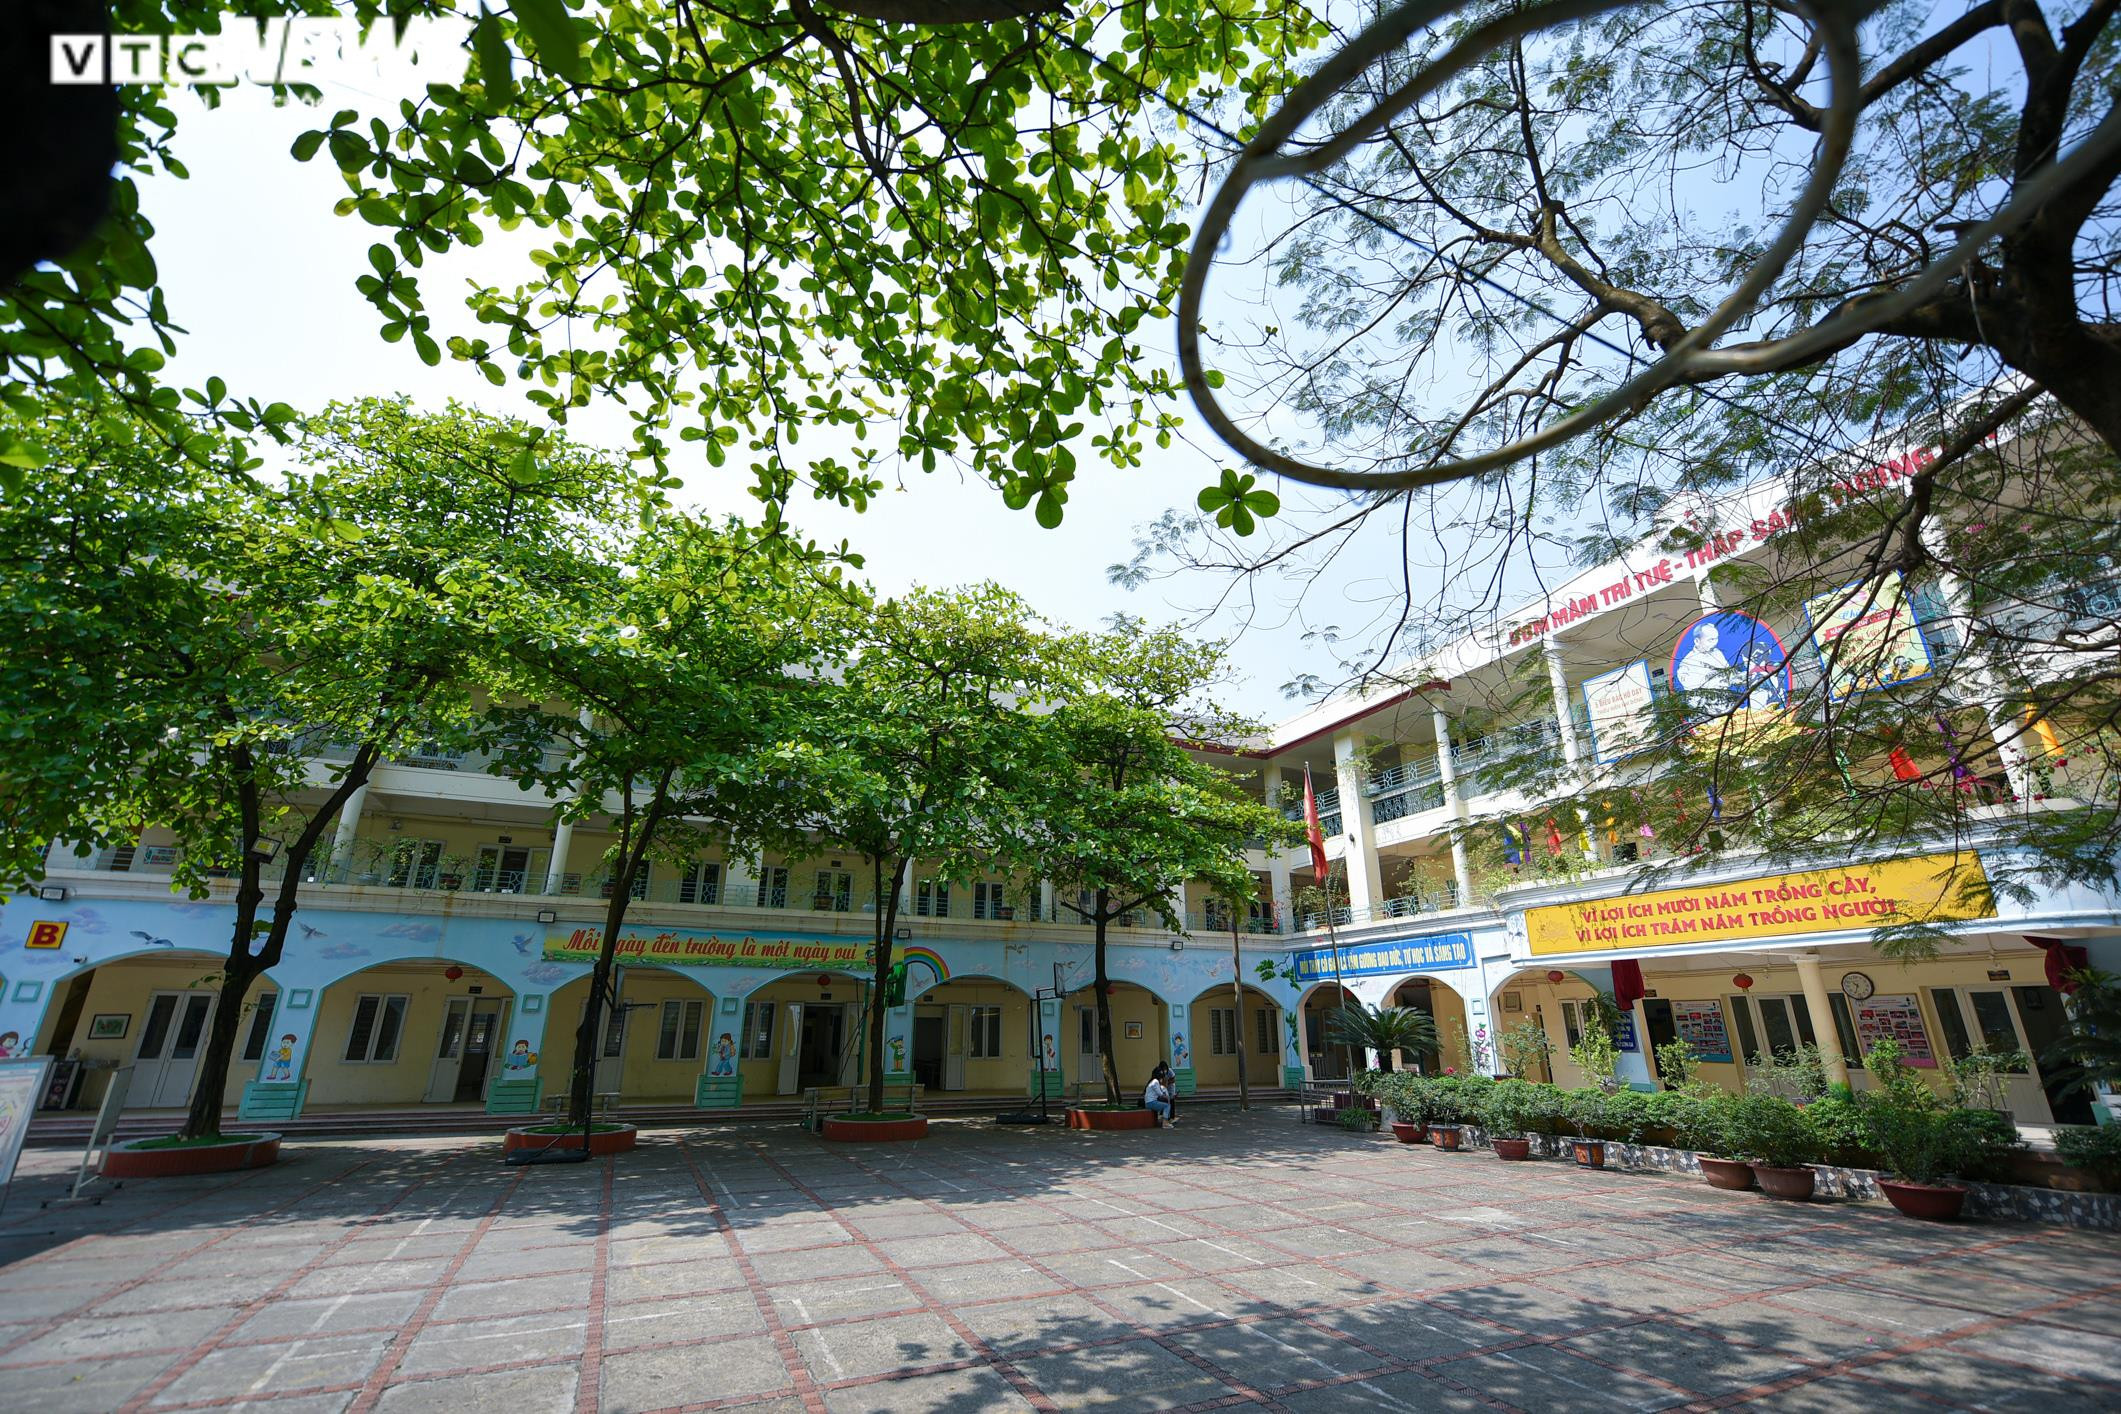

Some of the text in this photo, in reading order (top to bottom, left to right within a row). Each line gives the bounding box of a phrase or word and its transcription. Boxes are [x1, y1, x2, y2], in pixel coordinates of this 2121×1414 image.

[1599, 575, 1631, 606] TRÍ
[1634, 558, 1673, 594] TUỆ
[1575, 896, 1897, 943] VÌ LỢI ÍCH TRĂM NĂM TRỒNG NGƯỜI
[1582, 907, 1598, 923] VÌ
[1600, 907, 1625, 922] LỢI
[1628, 902, 1654, 919] ÍCH
[1656, 896, 1701, 915] MƯỜI
[1704, 892, 1748, 910] NĂM
[1828, 876, 1876, 896] CÂY,
[32, 924, 60, 945] B
[562, 927, 858, 962] Mỗi gày đến trường là một ngày vui
[1425, 944, 1434, 963] VÀ
[1434, 941, 1452, 962] SÁNG
[1452, 942, 1467, 964] TẠO
